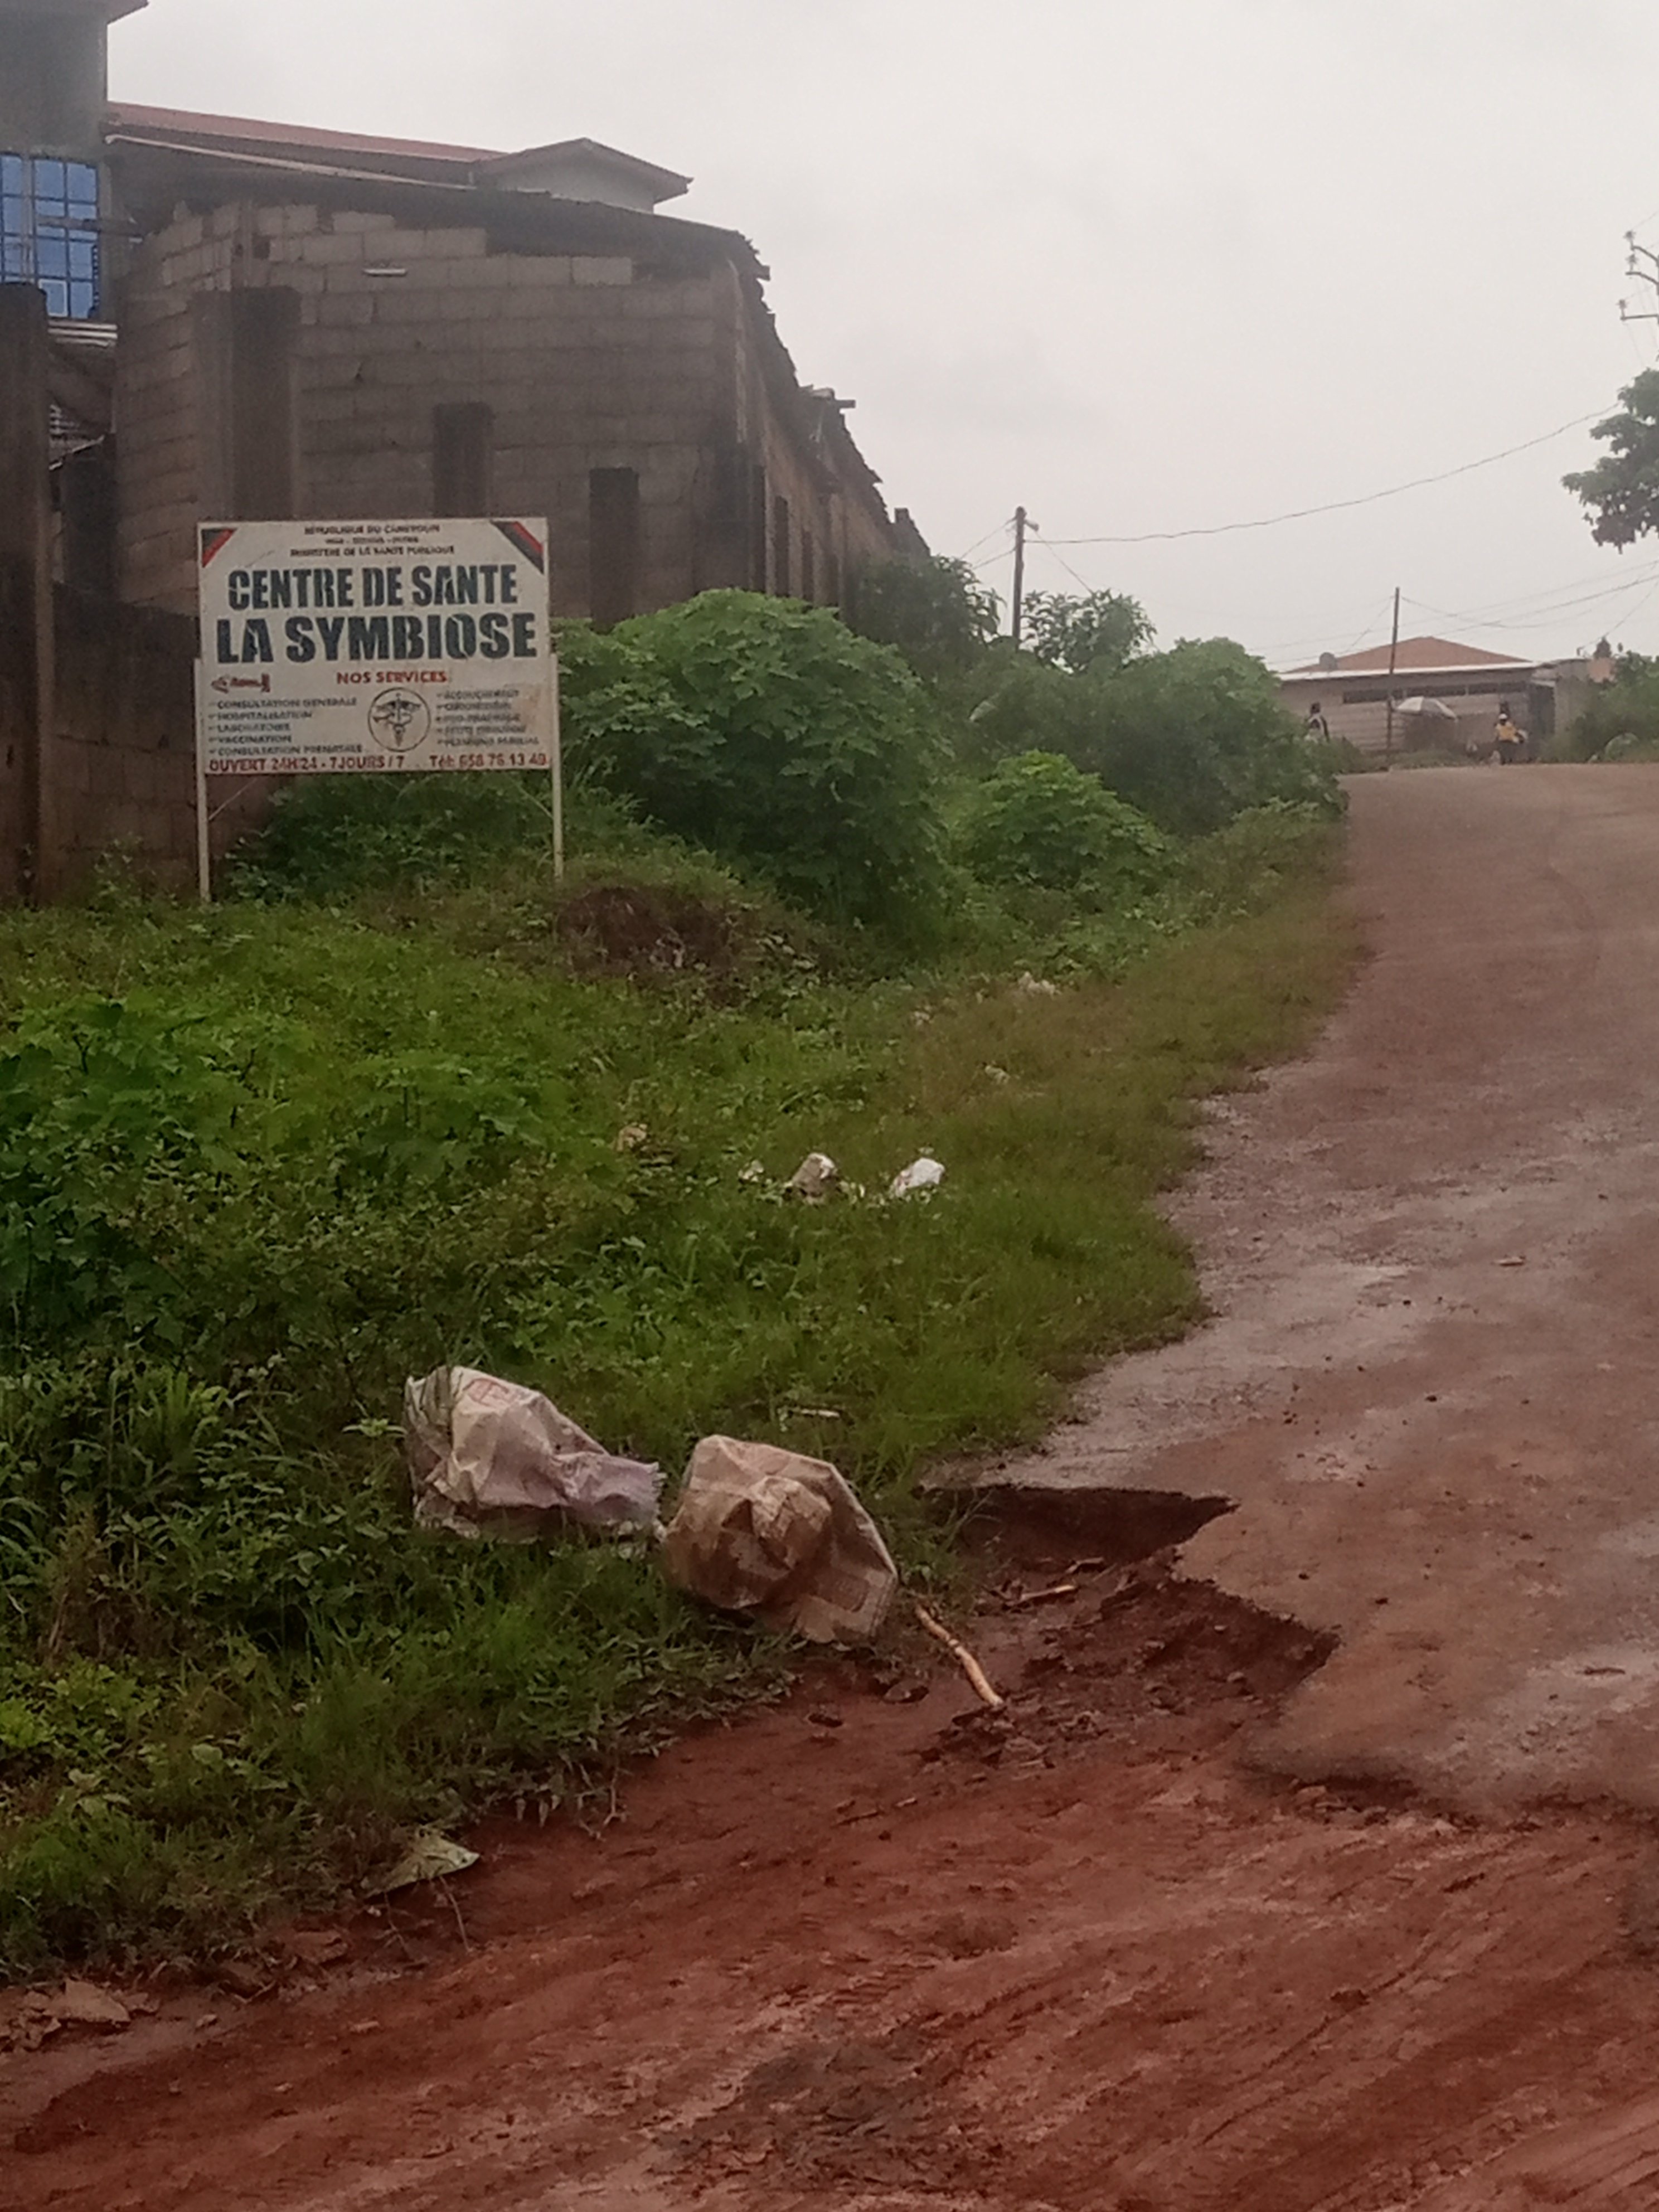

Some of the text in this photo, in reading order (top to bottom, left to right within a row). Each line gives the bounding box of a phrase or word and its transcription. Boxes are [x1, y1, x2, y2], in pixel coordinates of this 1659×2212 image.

[229, 564, 518, 611] CENTRE DE SANTE
[216, 612, 537, 664] LA SYMBIOSE
[336, 671, 448, 685] NOS SERVICES
[217, 698, 299, 710] CONSULTATION
[218, 735, 292, 744] VACCINATION
[209, 758, 266, 772] OUVERT
